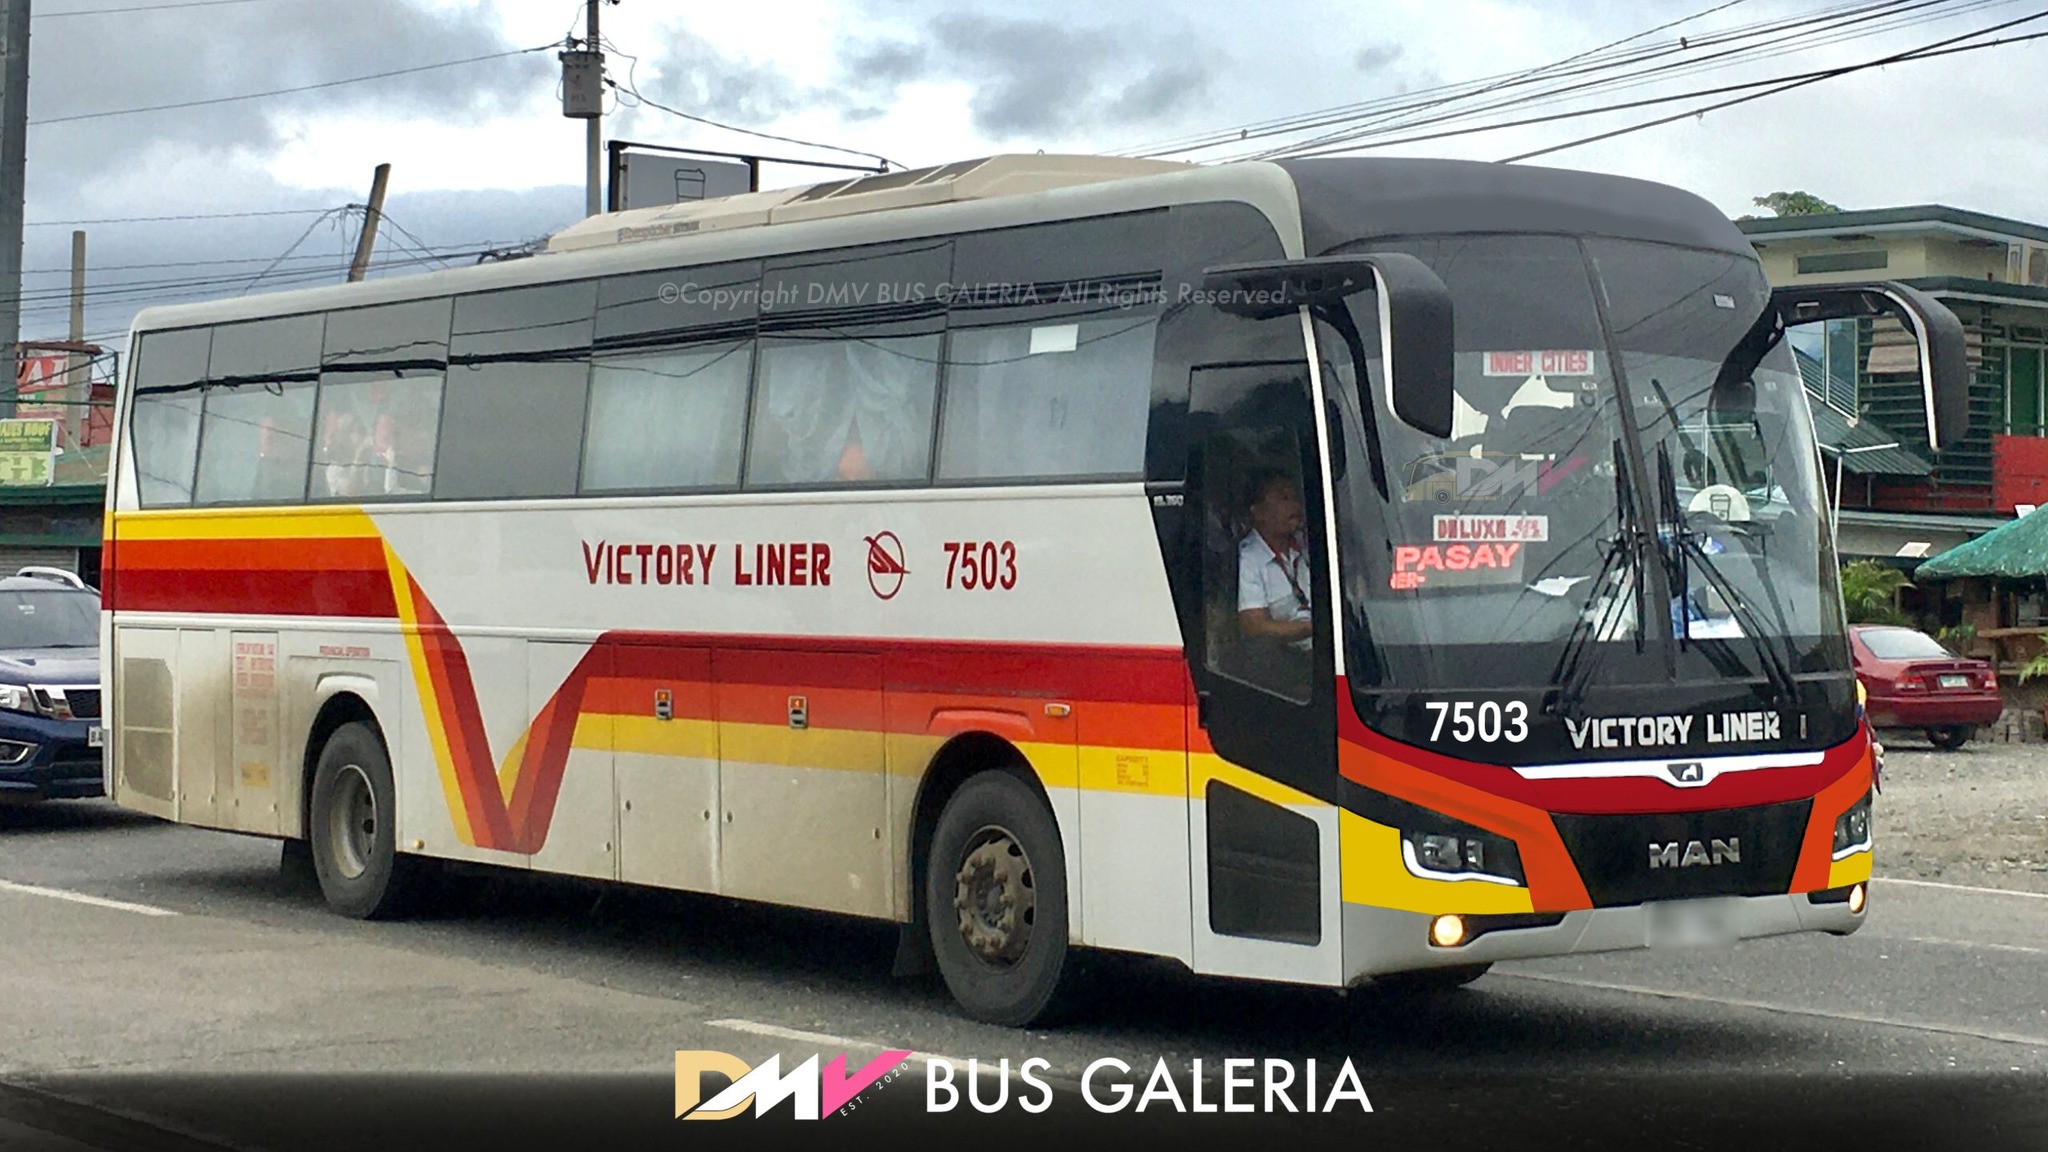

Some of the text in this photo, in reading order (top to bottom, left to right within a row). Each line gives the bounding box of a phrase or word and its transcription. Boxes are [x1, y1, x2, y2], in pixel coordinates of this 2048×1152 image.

[1541, 351, 1588, 373] CITIES
[581, 538, 831, 586] VICTORY LINER
[943, 540, 1017, 591] 7503
[1394, 542, 1520, 572] PASAY
[1425, 700, 1530, 743] 7503
[1564, 711, 1781, 749] VICTORY LINER
[1648, 837, 1741, 869] MAN
